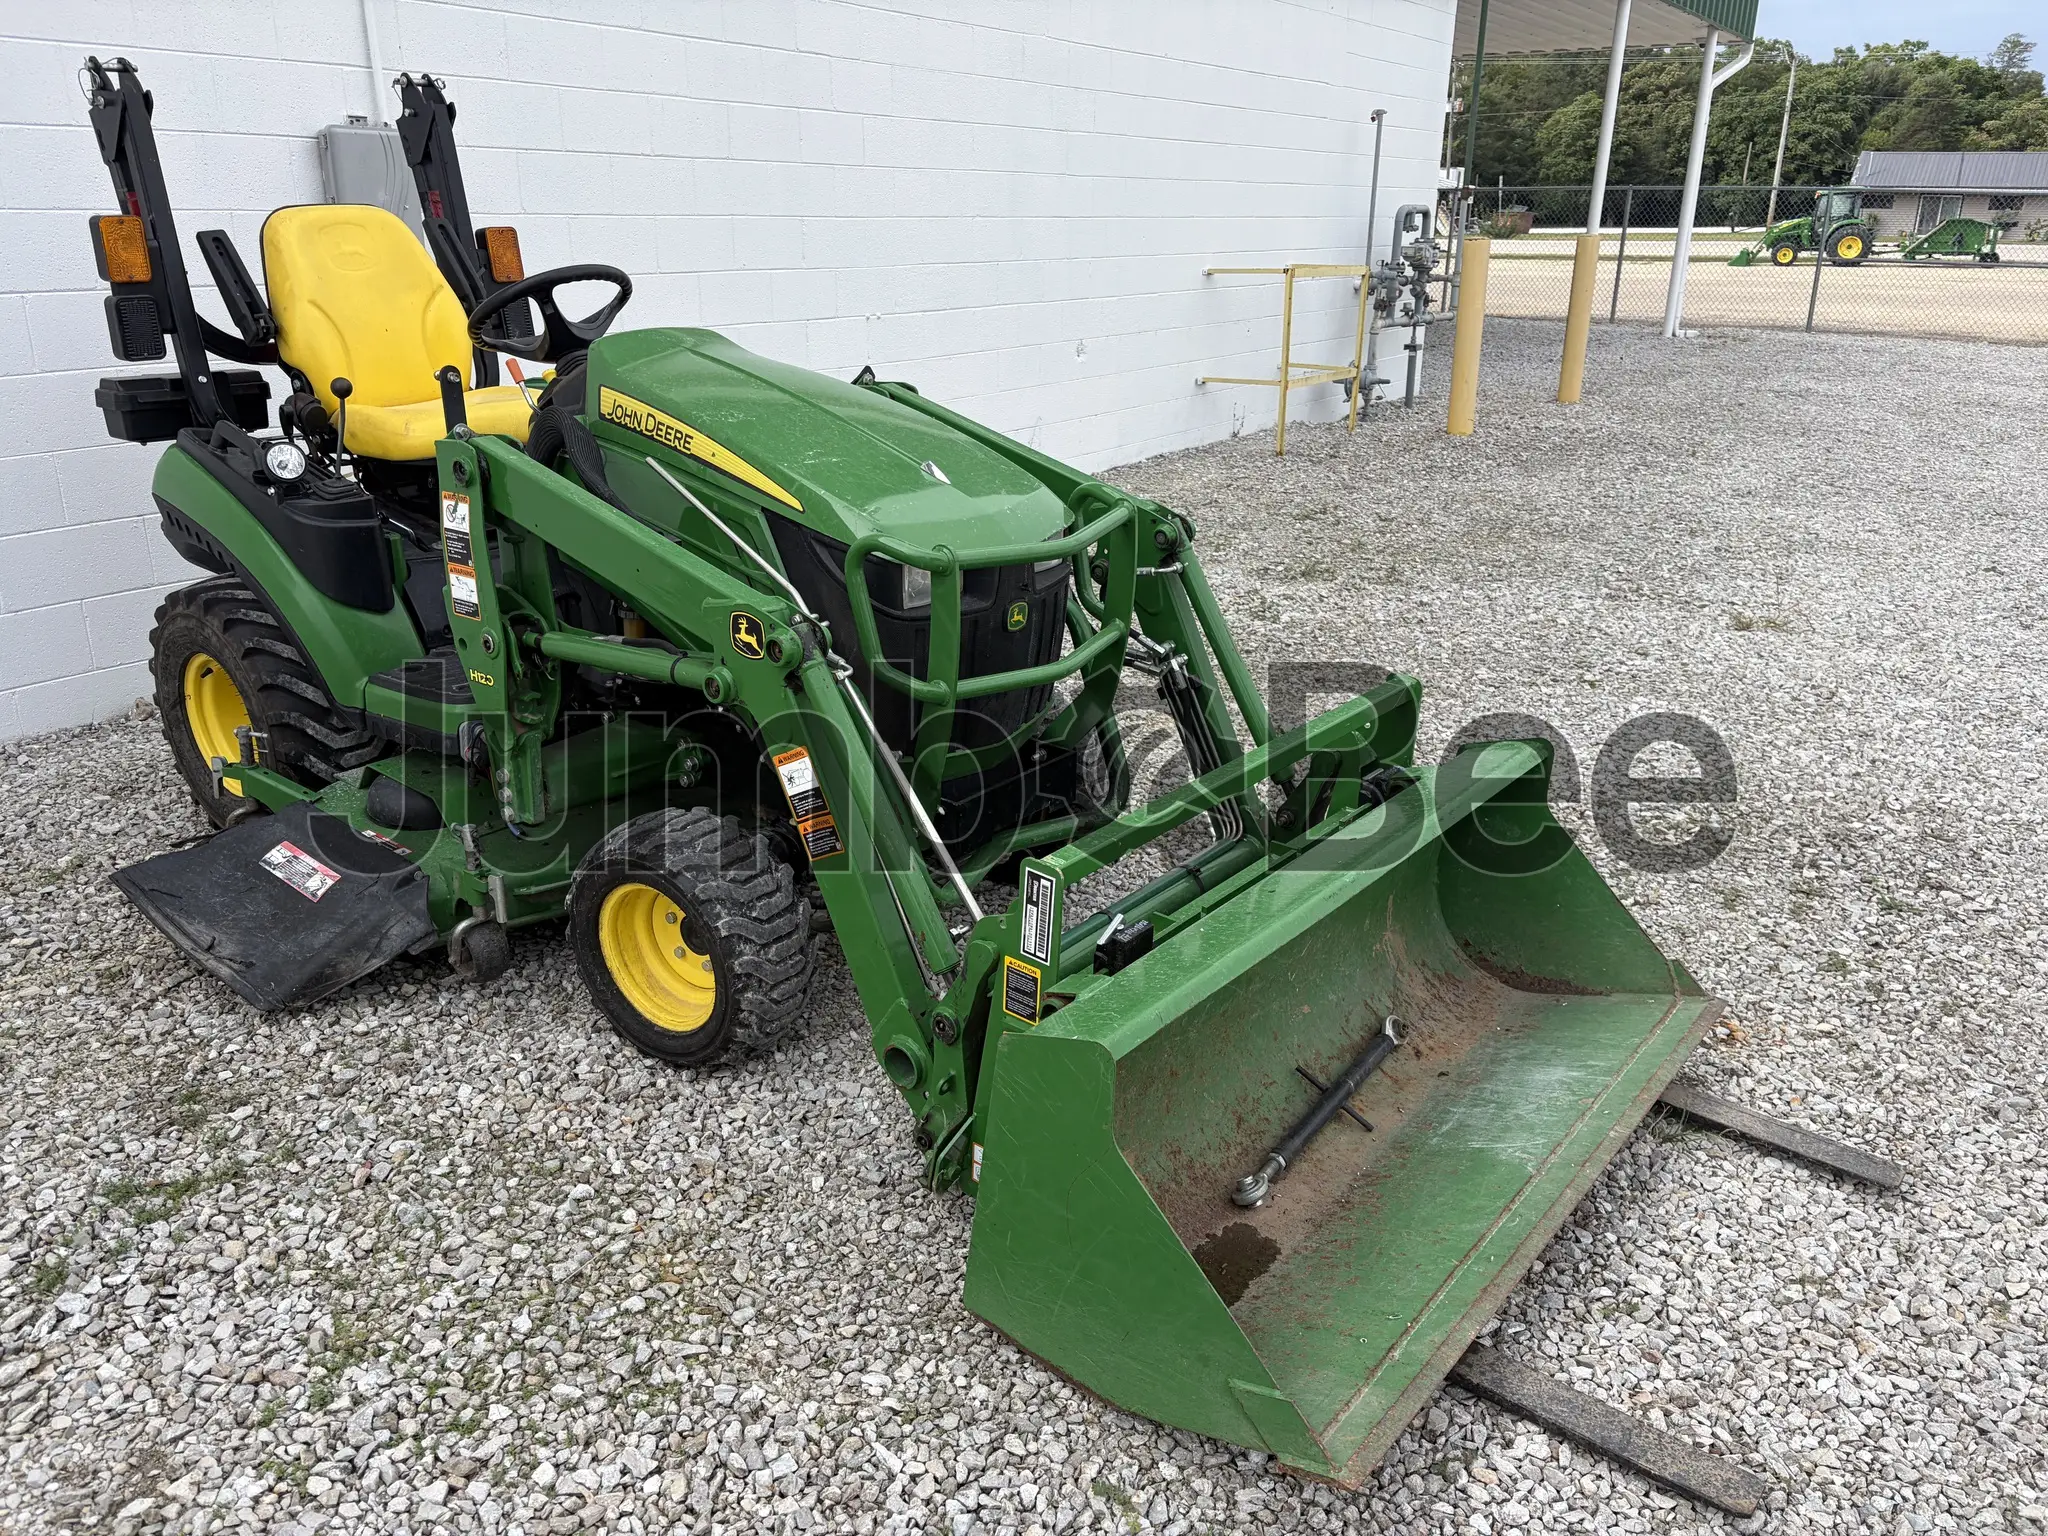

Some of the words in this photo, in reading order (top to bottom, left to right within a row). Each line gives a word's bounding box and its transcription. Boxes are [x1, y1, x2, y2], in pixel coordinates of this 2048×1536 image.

[606, 399, 643, 429] JOHN
[644, 412, 694, 451] DEERE
[783, 749, 805, 762] WARNING
[809, 818, 831, 830] WARNING
[1012, 961, 1038, 976] CAUTION
